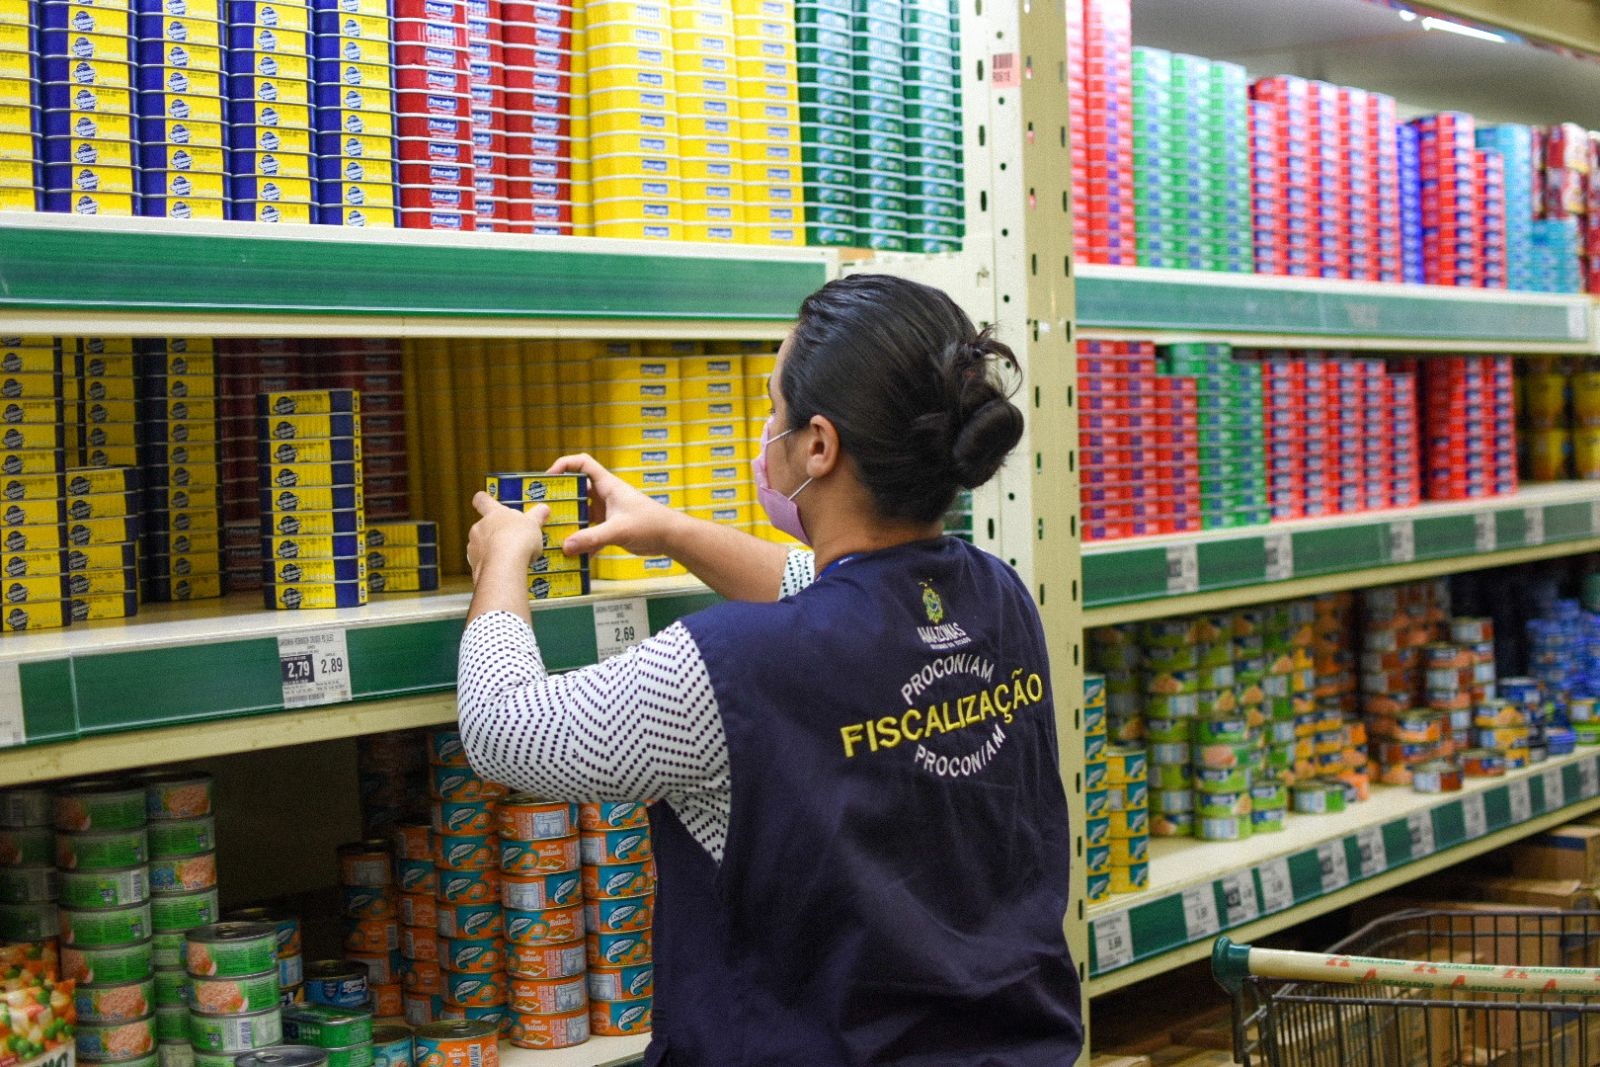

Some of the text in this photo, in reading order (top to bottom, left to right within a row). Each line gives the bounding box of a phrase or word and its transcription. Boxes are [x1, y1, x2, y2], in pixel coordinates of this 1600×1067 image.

[614, 626, 634, 643] 2,69
[917, 622, 967, 643] AMAZONAS
[288, 661, 310, 680] 2,79
[840, 668, 1043, 758] FISCALIZAÇÃO
